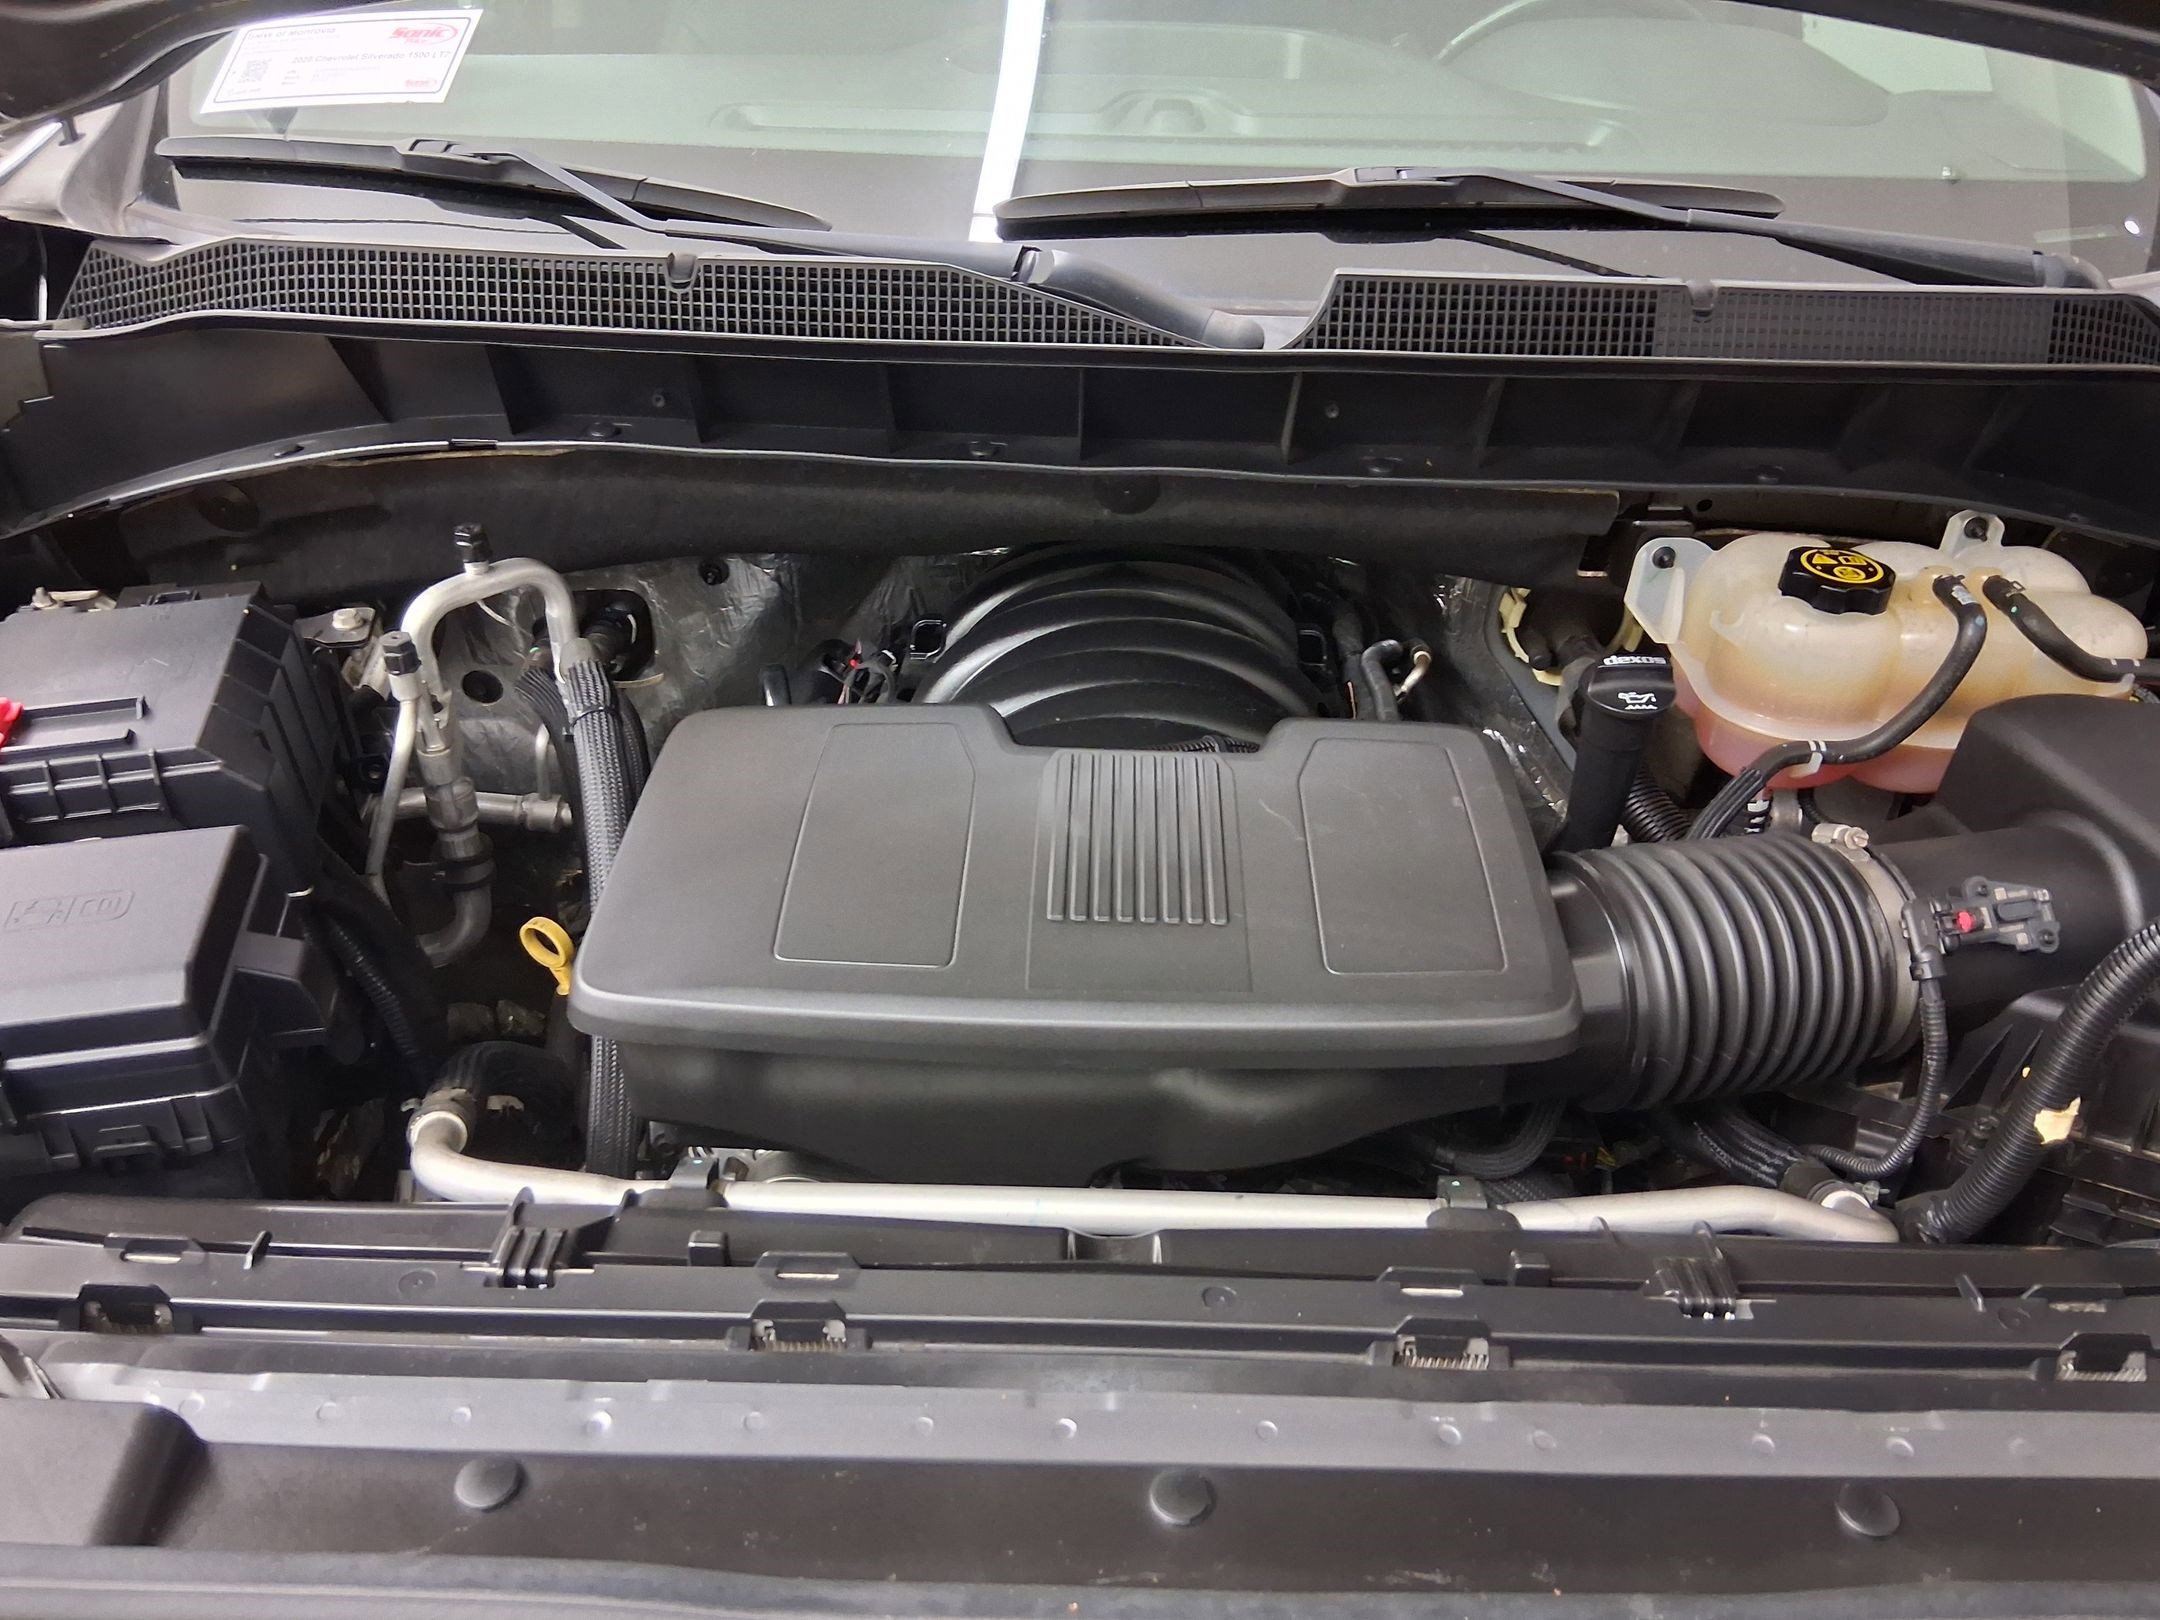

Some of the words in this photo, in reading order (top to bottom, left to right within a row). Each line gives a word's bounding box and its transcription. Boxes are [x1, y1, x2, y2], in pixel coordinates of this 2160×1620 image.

[389, 27, 449, 39] Sonic
[315, 54, 359, 63] Chevrolet
[361, 52, 405, 61] Silverado
[408, 51, 430, 59] 1500
[1603, 655, 1667, 665] dexos
